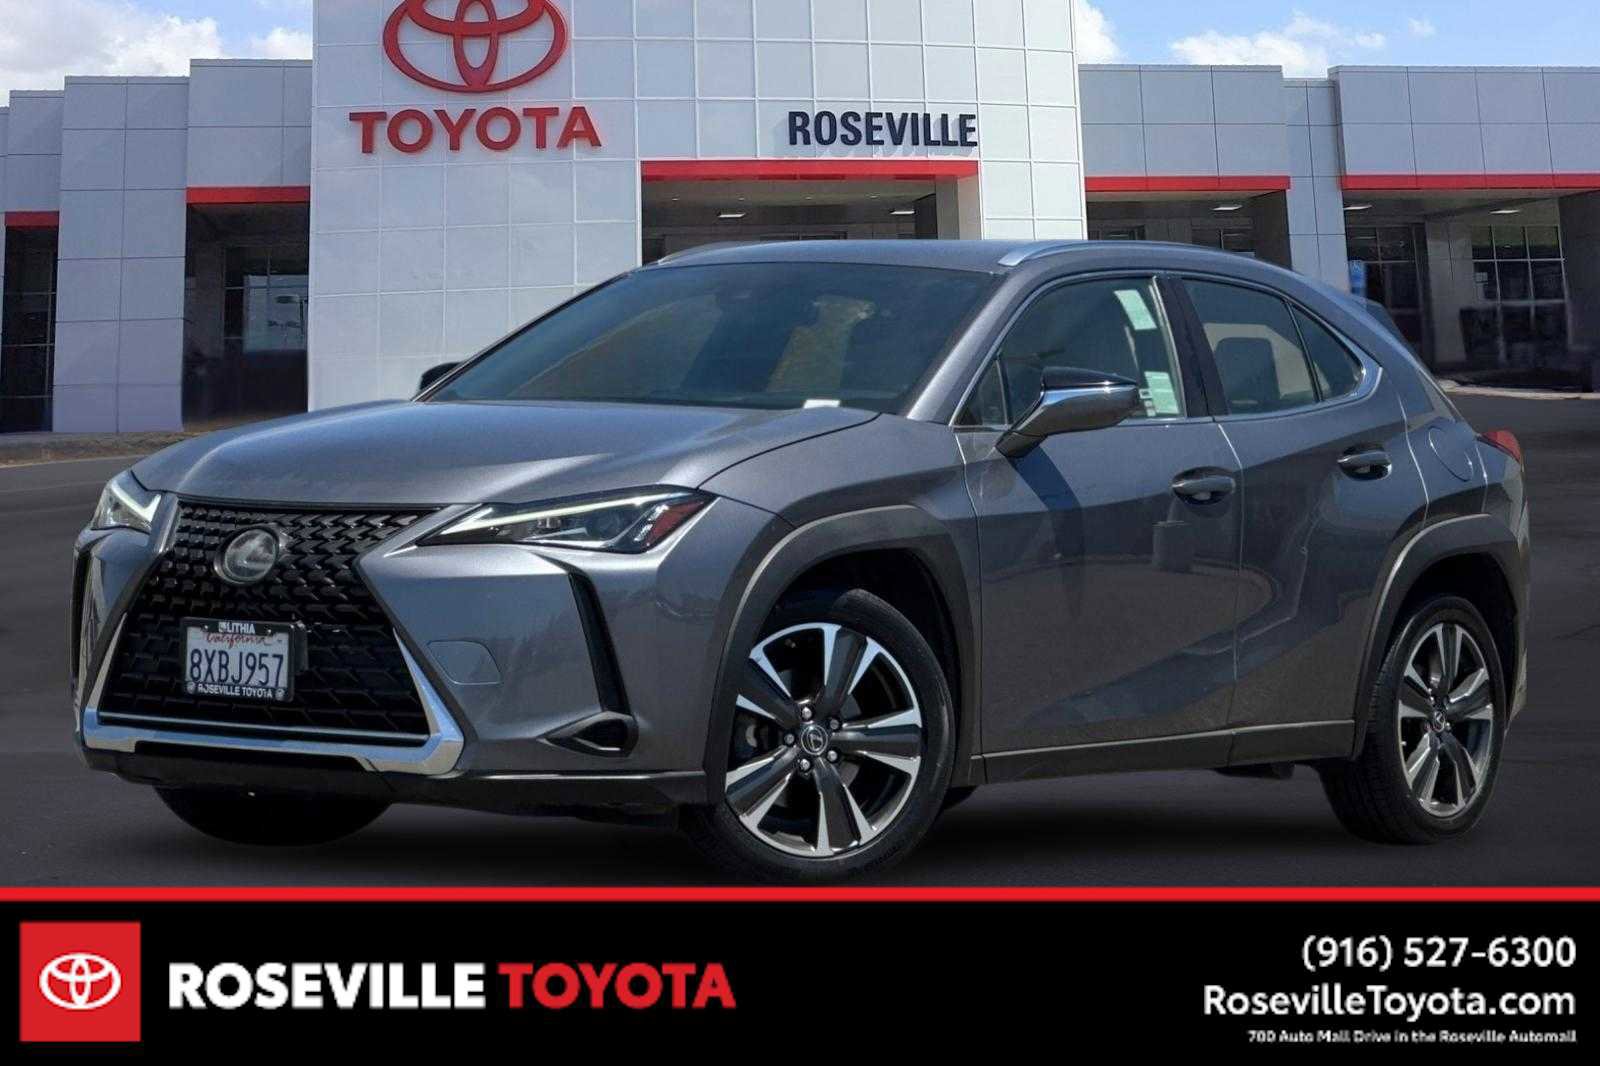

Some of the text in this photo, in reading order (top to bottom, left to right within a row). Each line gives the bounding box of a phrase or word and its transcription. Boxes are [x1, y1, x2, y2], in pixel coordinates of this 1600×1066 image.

[349, 106, 602, 154] TOYOTA
[788, 111, 978, 147] ROSEVILLE
[227, 622, 255, 635] LITHIA
[190, 649, 284, 688] 8XBJ957
[198, 684, 272, 698] ROSEVILLE TOYOTA
